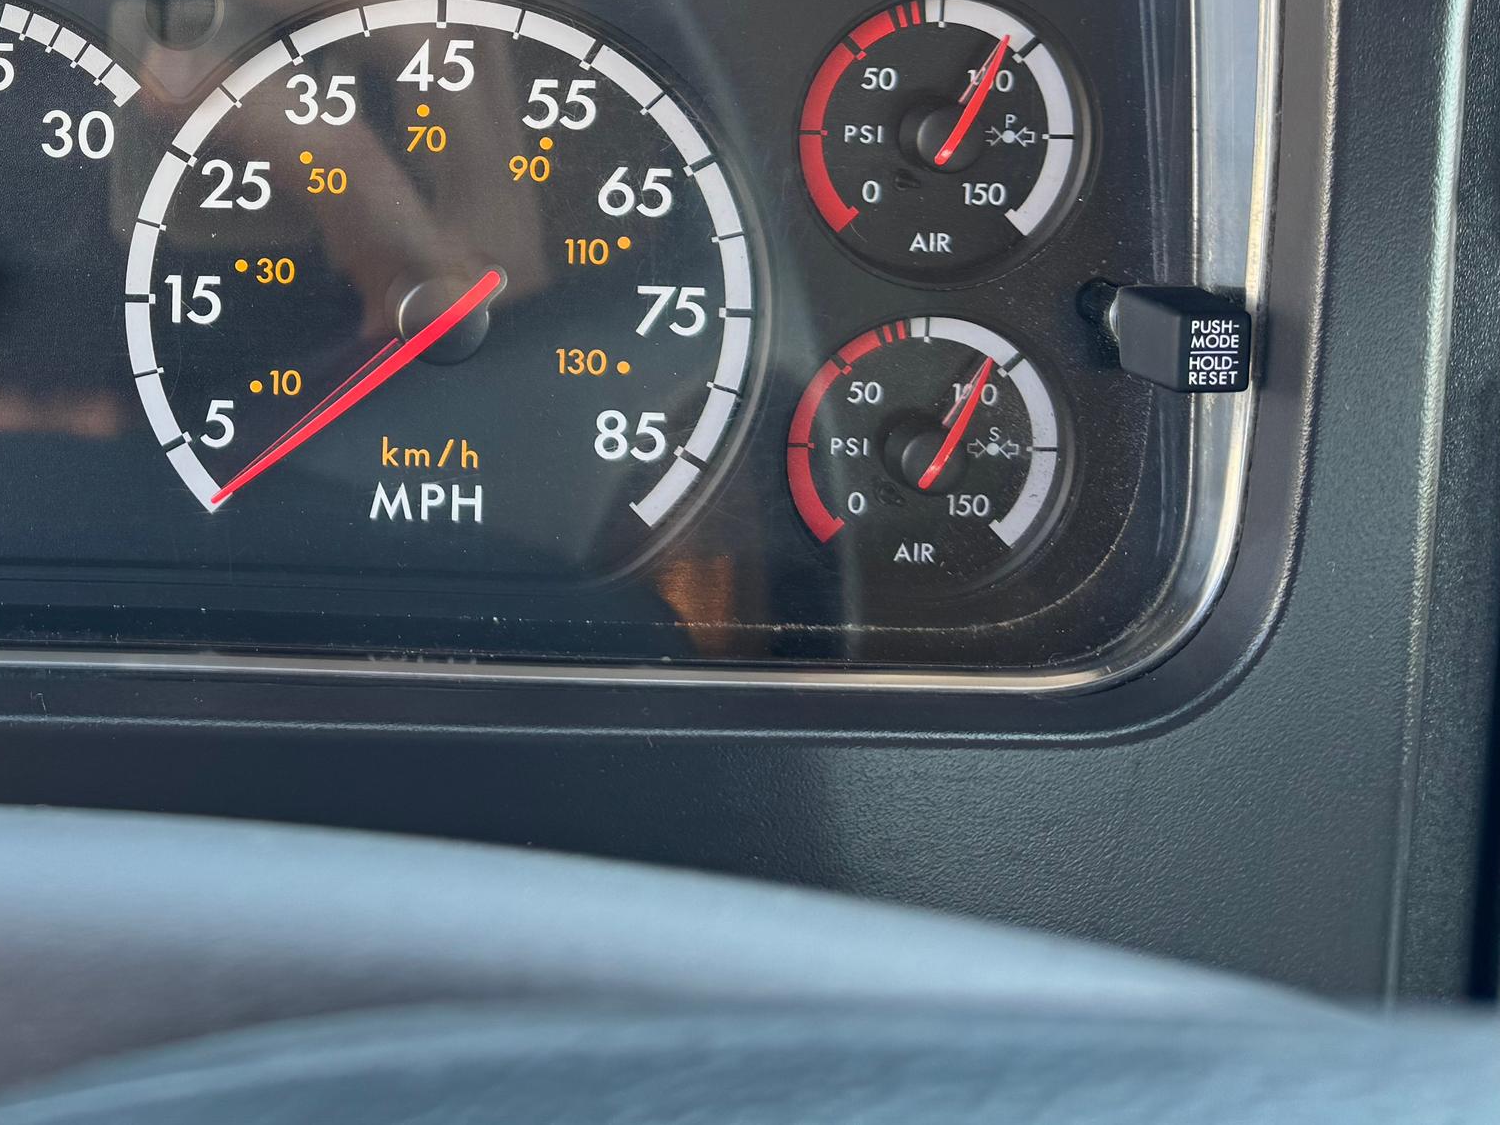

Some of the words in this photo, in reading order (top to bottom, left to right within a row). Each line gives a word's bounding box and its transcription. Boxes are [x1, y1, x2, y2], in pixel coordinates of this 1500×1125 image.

[397, 40, 475, 92] 45
[861, 68, 897, 91] 50
[285, 74, 357, 126] 35
[522, 79, 597, 130] 55
[41, 110, 115, 159] 30
[407, 127, 447, 152] 70
[844, 125, 884, 144] PSI
[307, 168, 347, 194] 50
[509, 155, 550, 183] 90
[201, 160, 272, 210] 25
[598, 167, 673, 218] 65
[862, 181, 881, 203] 0
[962, 183, 1005, 206] 150
[565, 239, 608, 265] 110
[909, 232, 952, 253] AIR
[256, 257, 295, 285] 30
[165, 274, 222, 325] 15
[636, 285, 706, 337] 75
[1191, 334, 1239, 349] MODE
[556, 349, 607, 375] 130
[269, 370, 301, 396] 10
[1188, 371, 1238, 386] RESET
[847, 381, 883, 404] 50
[201, 400, 235, 448] 5
[595, 412, 667, 462] 85
[382, 437, 479, 469] km/h
[830, 438, 869, 457] PSI
[369, 482, 483, 522] MPH
[848, 492, 866, 514] 0
[946, 494, 990, 516] 150
[893, 542, 935, 563] AIR
